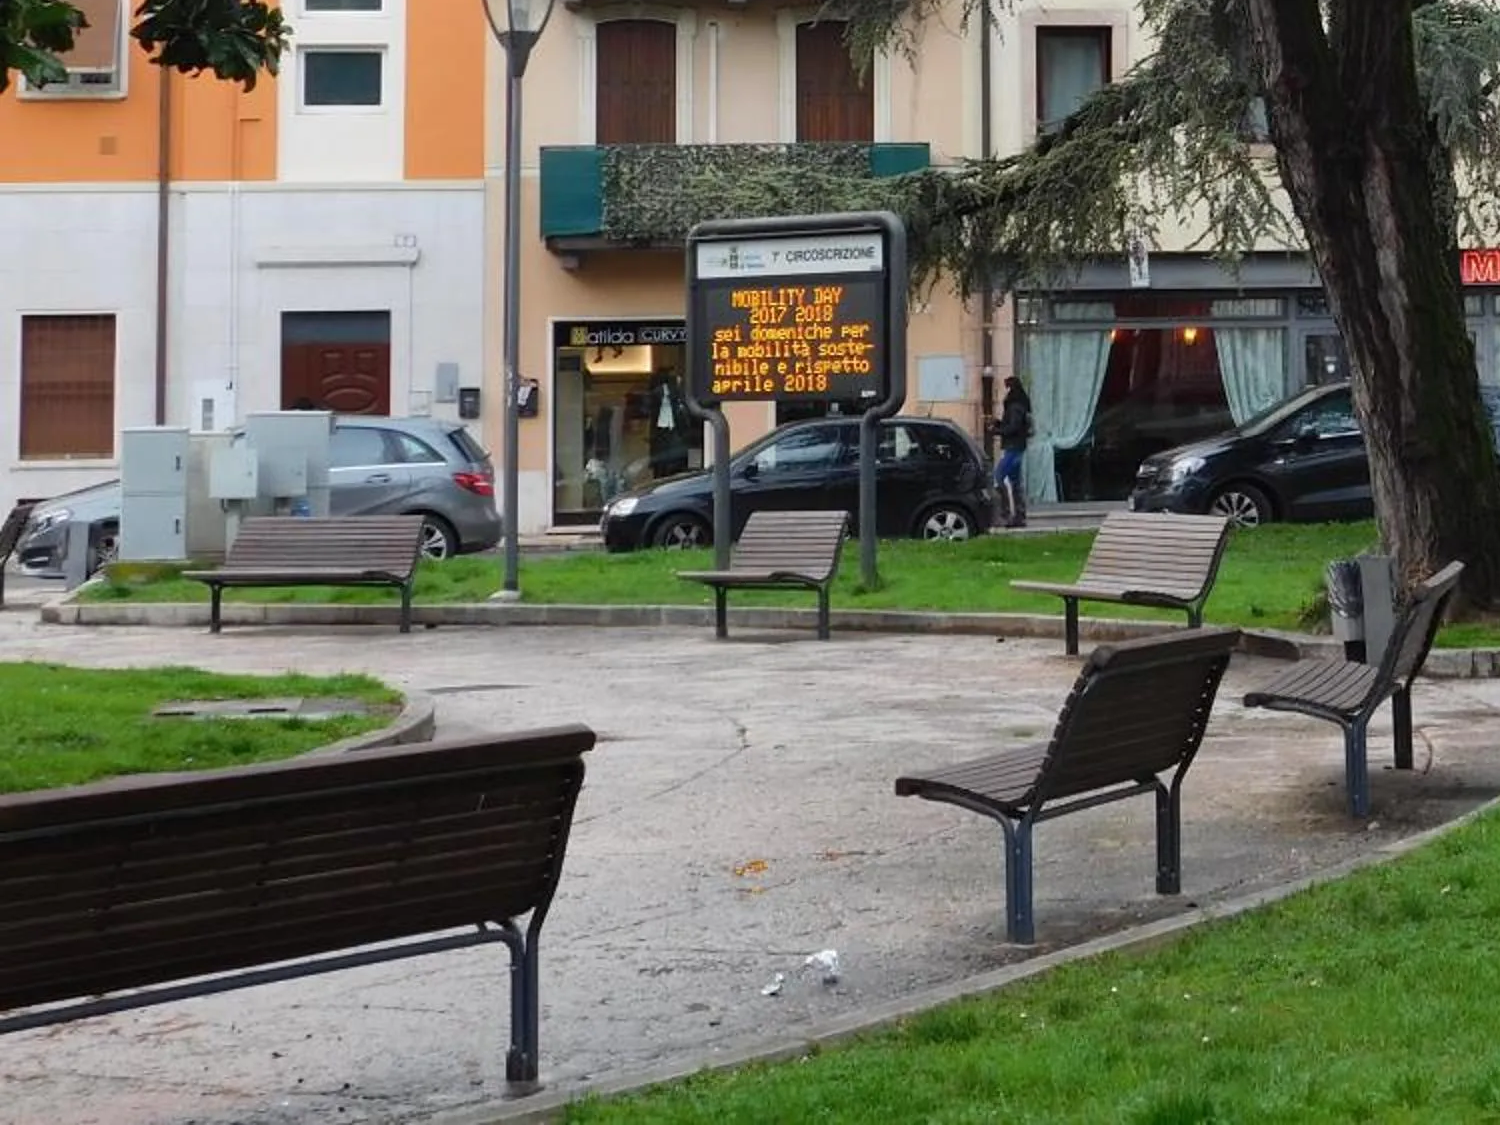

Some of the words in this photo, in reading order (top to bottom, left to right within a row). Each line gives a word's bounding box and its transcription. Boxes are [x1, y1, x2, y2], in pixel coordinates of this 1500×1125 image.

[785, 245, 876, 264] CIRCOSCRIZIONE
[731, 287, 805, 308] MOBILITY
[813, 286, 843, 305] DAY
[750, 306, 787, 324] 2017
[795, 304, 833, 322] 2018
[714, 324, 742, 342] sei
[750, 323, 833, 341] domeniche
[840, 324, 870, 339] per
[712, 342, 730, 360] la
[737, 340, 811, 359] mobilità
[818, 339, 875, 357] soste-
[714, 358, 769, 376] nibile
[777, 361, 788, 374] e
[795, 356, 870, 375] rispetto
[711, 376, 774, 394] aprile
[784, 374, 828, 392] 2018
